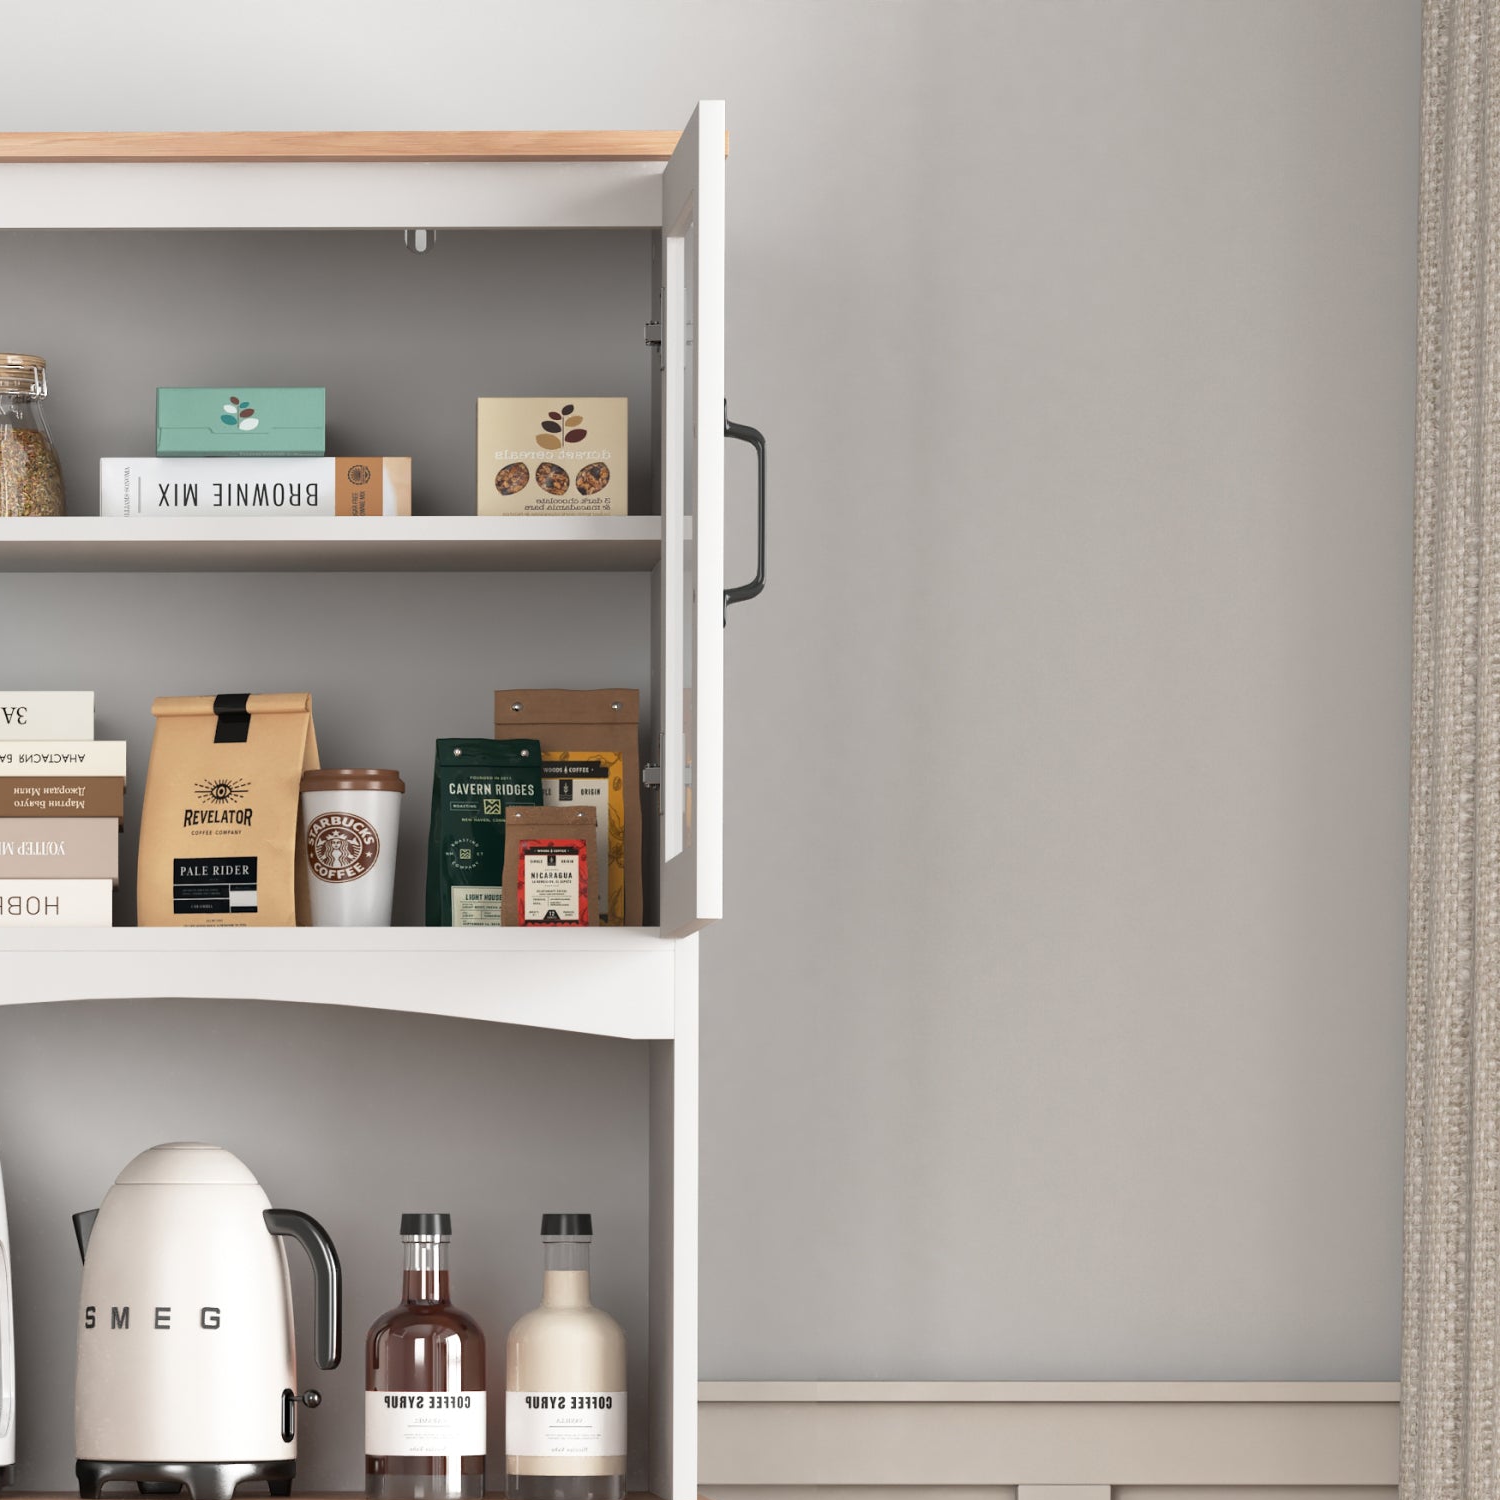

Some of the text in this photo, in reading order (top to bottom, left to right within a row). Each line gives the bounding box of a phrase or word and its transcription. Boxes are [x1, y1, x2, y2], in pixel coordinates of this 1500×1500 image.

[159, 483, 317, 506] BROWNIE MIX
[19, 754, 85, 763] АНАСТАСИЯ
[449, 783, 491, 795] CAVERN
[495, 784, 534, 795] RIDGES
[49, 798, 84, 808] Мартин
[183, 808, 253, 828] REVELATOR
[308, 816, 375, 846] STARBUCKS
[181, 865, 249, 876] PALE RIDER
[314, 862, 365, 879] COFFEE
[84, 1306, 221, 1330] SMEG
